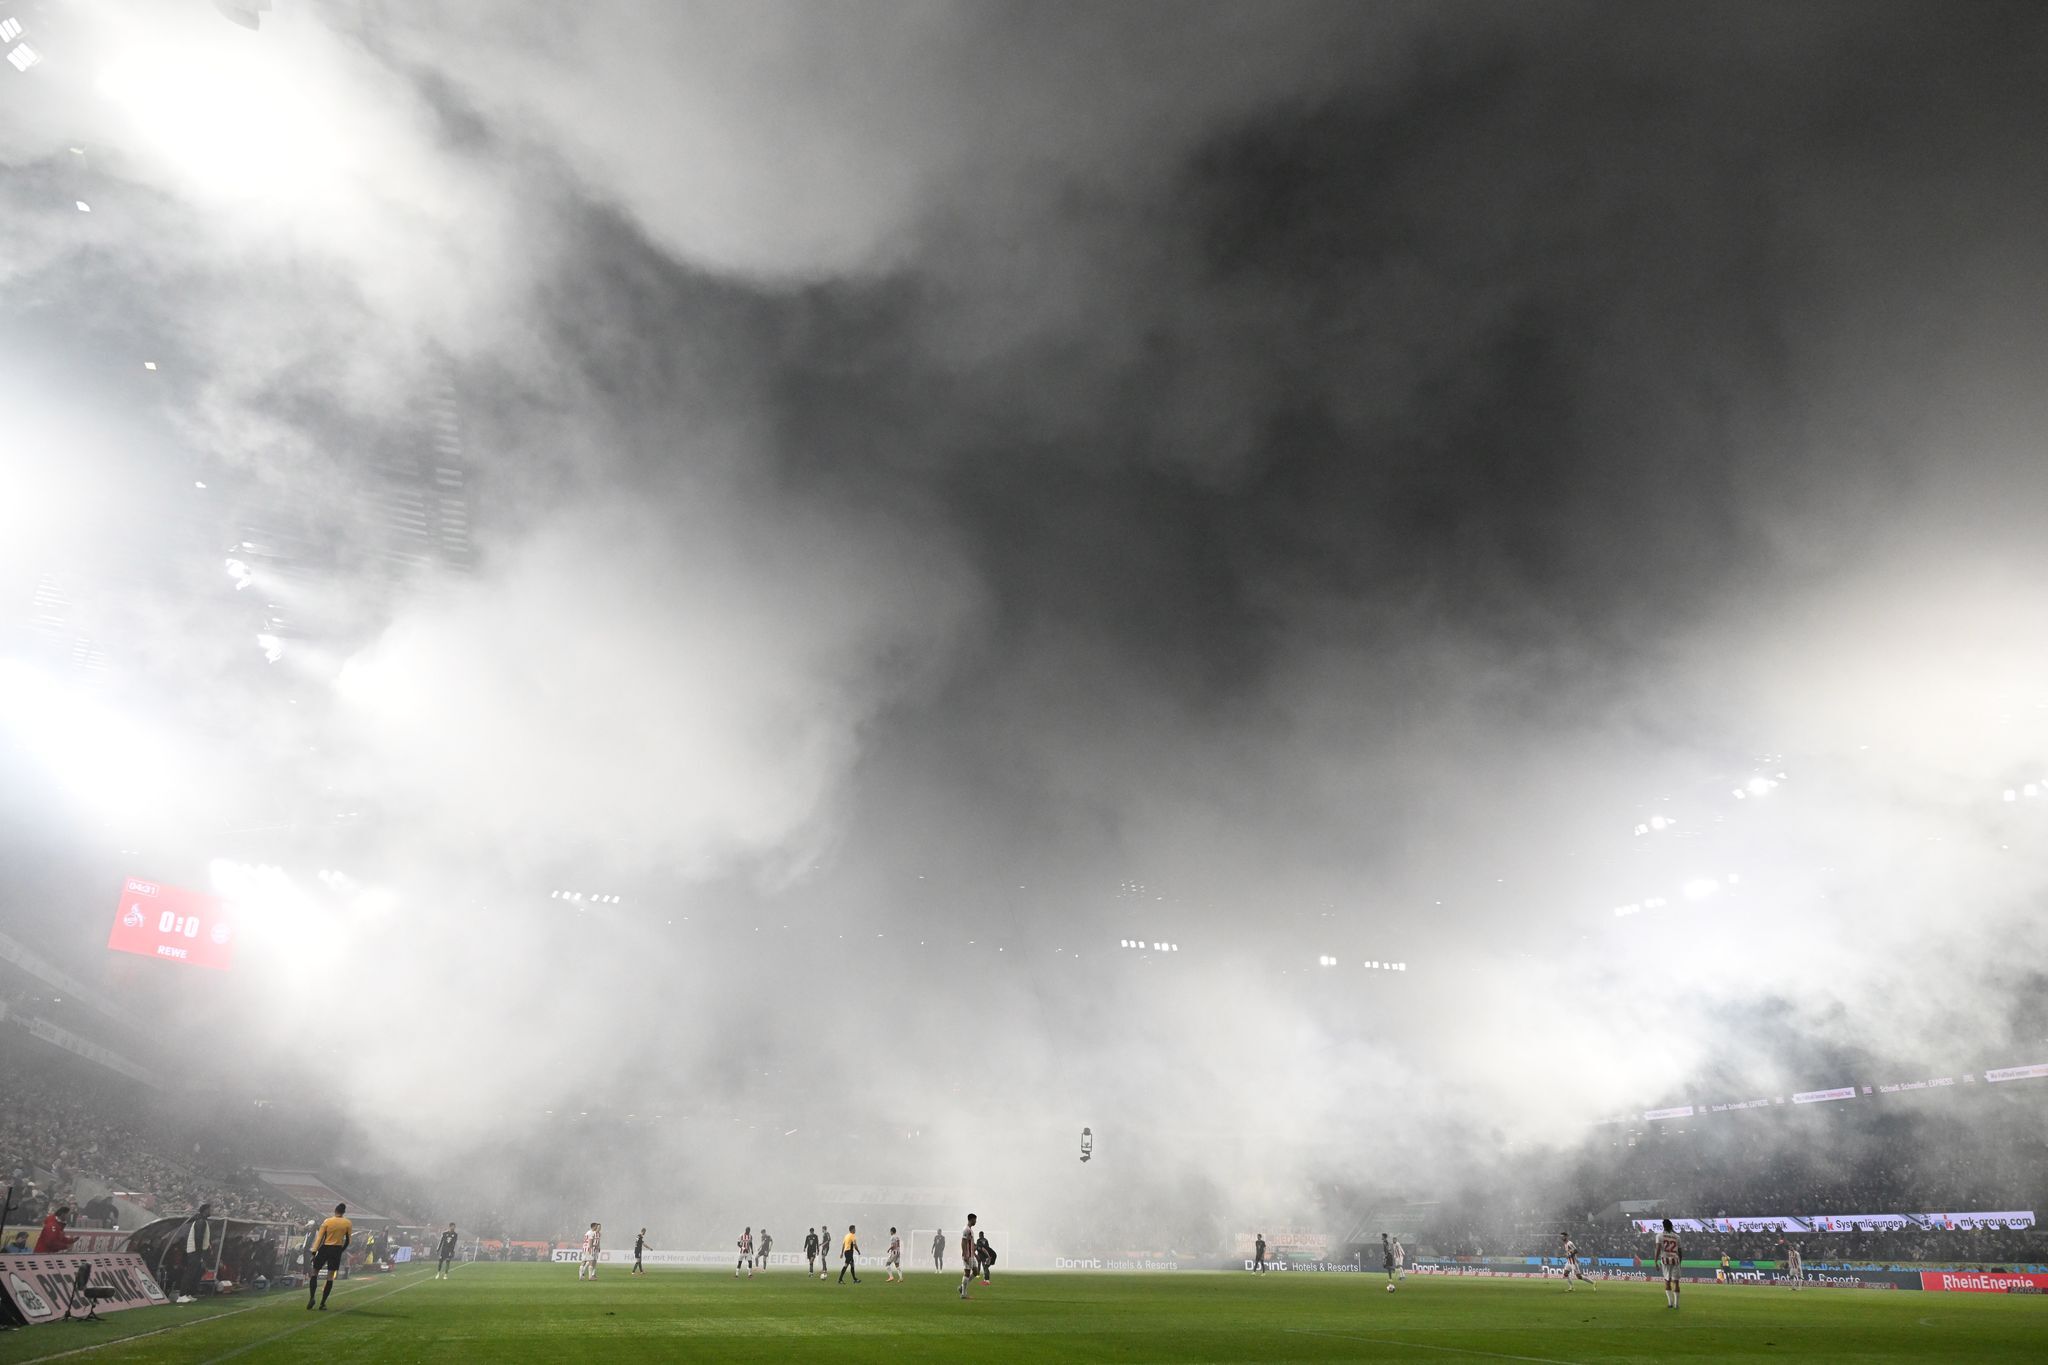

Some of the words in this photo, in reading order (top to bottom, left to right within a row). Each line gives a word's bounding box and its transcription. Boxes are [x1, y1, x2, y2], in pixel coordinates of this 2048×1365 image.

[158, 911, 200, 938] 0:0
[157, 945, 188, 959] REWE
[1664, 1240, 1677, 1252] 22
[1055, 1257, 1101, 1269] Dorint
[1106, 1260, 1134, 1269] Hotels
[1145, 1260, 1178, 1270] Resorts
[1292, 1262, 1318, 1272] Hotels
[1319, 1263, 1325, 1272] &
[1328, 1263, 1359, 1272] Resorts
[1412, 1263, 1440, 1271] Dorint
[1716, 1269, 1765, 1280] Drint
[1943, 1274, 2033, 1290] RheinEnergie
